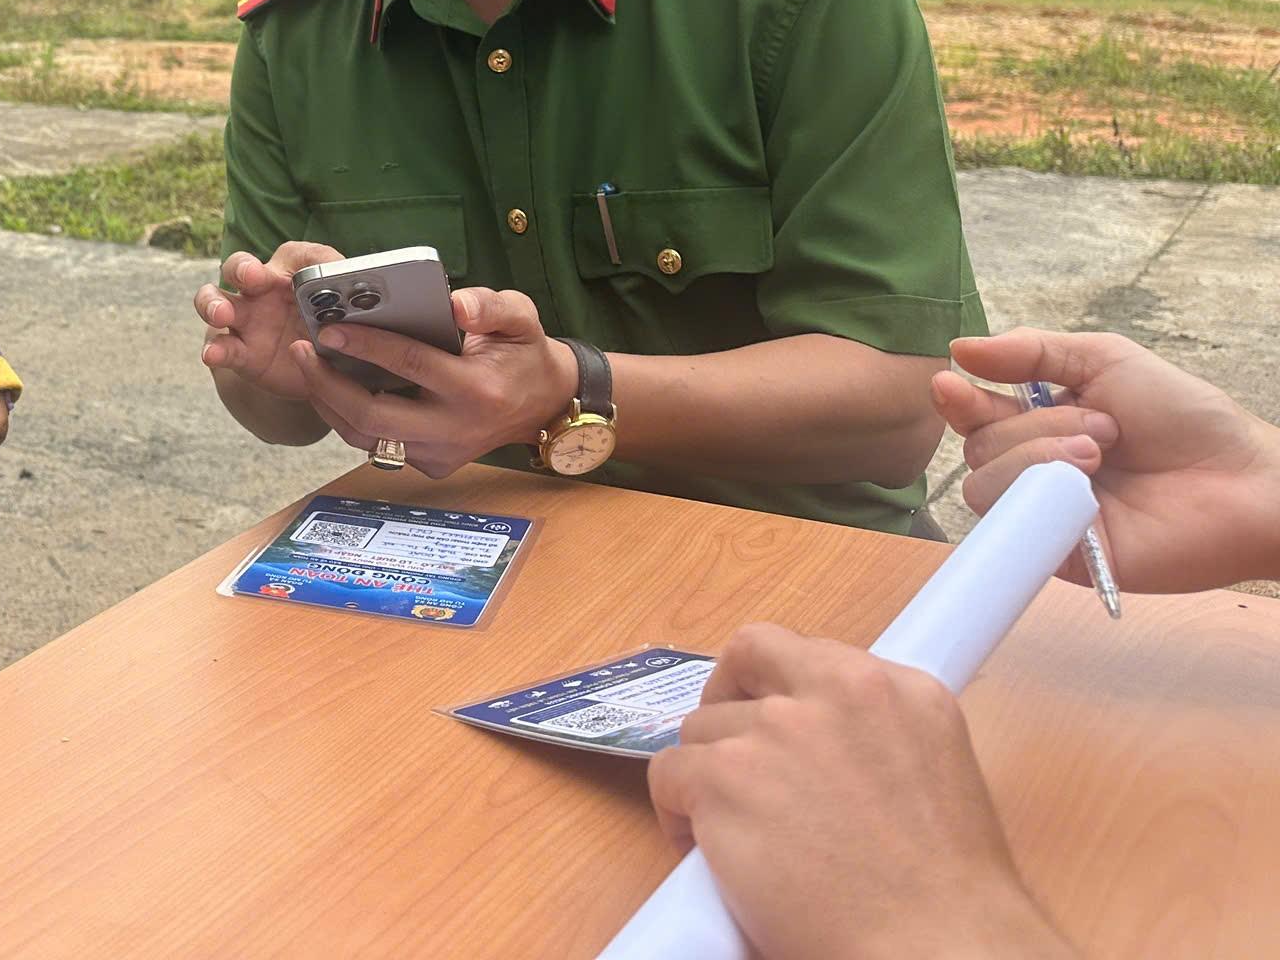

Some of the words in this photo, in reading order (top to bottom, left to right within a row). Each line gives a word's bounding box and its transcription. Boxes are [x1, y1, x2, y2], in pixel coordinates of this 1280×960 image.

[287, 567, 352, 584] TOÀN
[307, 563, 366, 577] ĐỒNG
[352, 577, 389, 589] AN
[370, 571, 431, 586] CỘNG
[390, 585, 434, 596] THẺ
